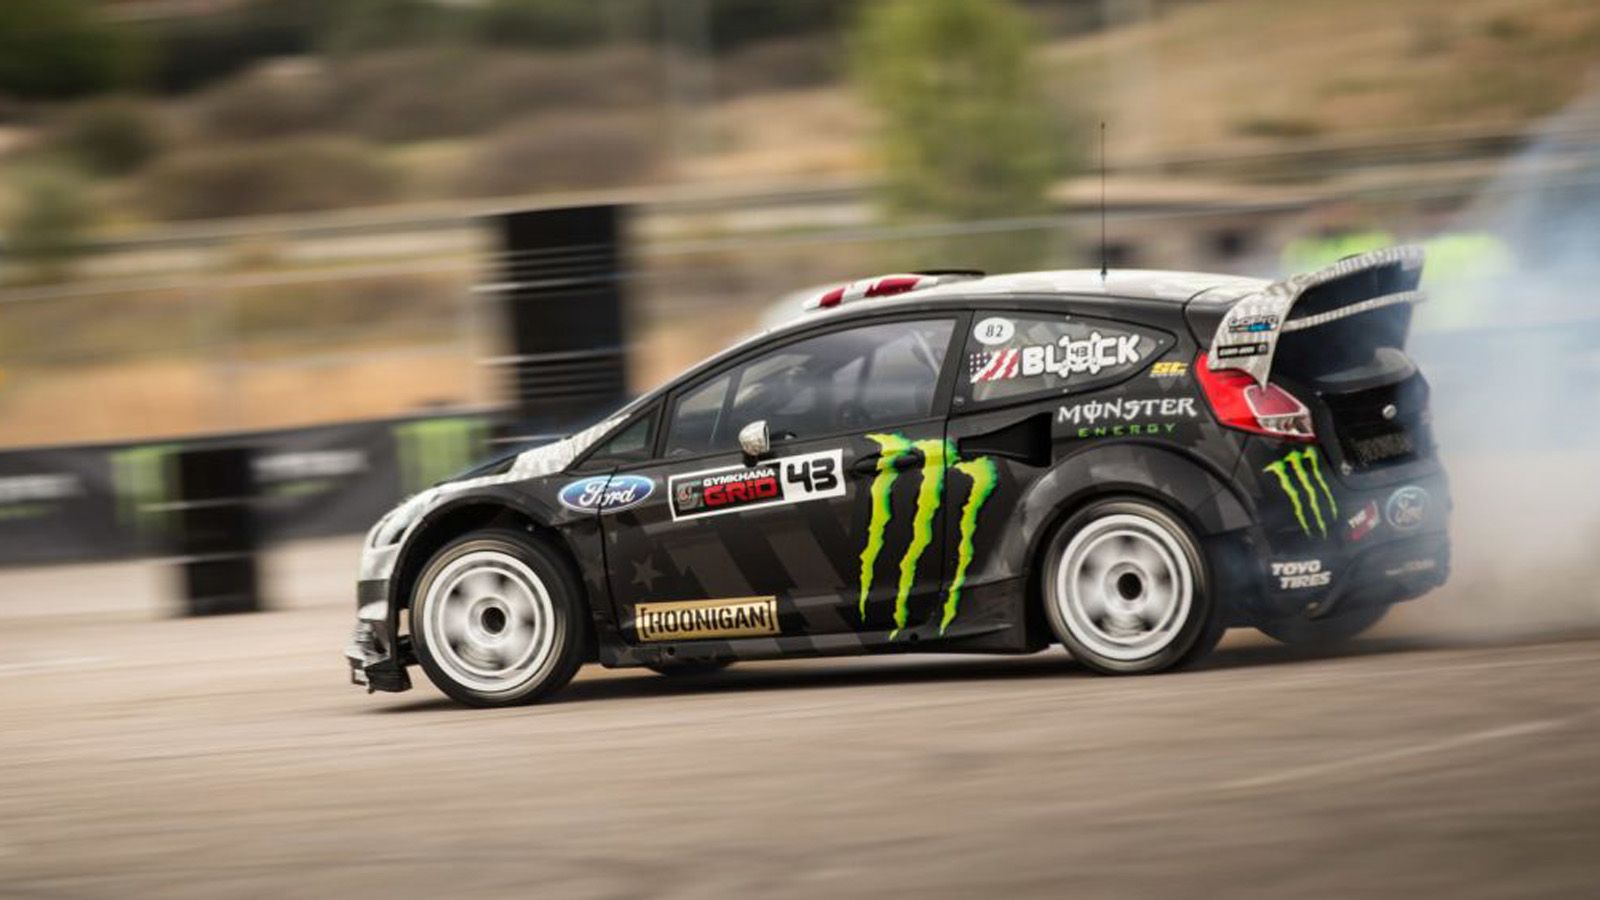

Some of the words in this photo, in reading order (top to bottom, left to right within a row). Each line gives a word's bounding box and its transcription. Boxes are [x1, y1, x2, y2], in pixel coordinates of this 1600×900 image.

[985, 322, 1004, 338] 82
[1057, 397, 1198, 424] MONSTER
[1077, 423, 1177, 438] ENERGY
[703, 468, 776, 487] GYMKHANA
[786, 457, 838, 493] 43
[578, 480, 637, 507] Ford
[1271, 559, 1321, 576] TOYO
[1279, 571, 1332, 589] TIRES
